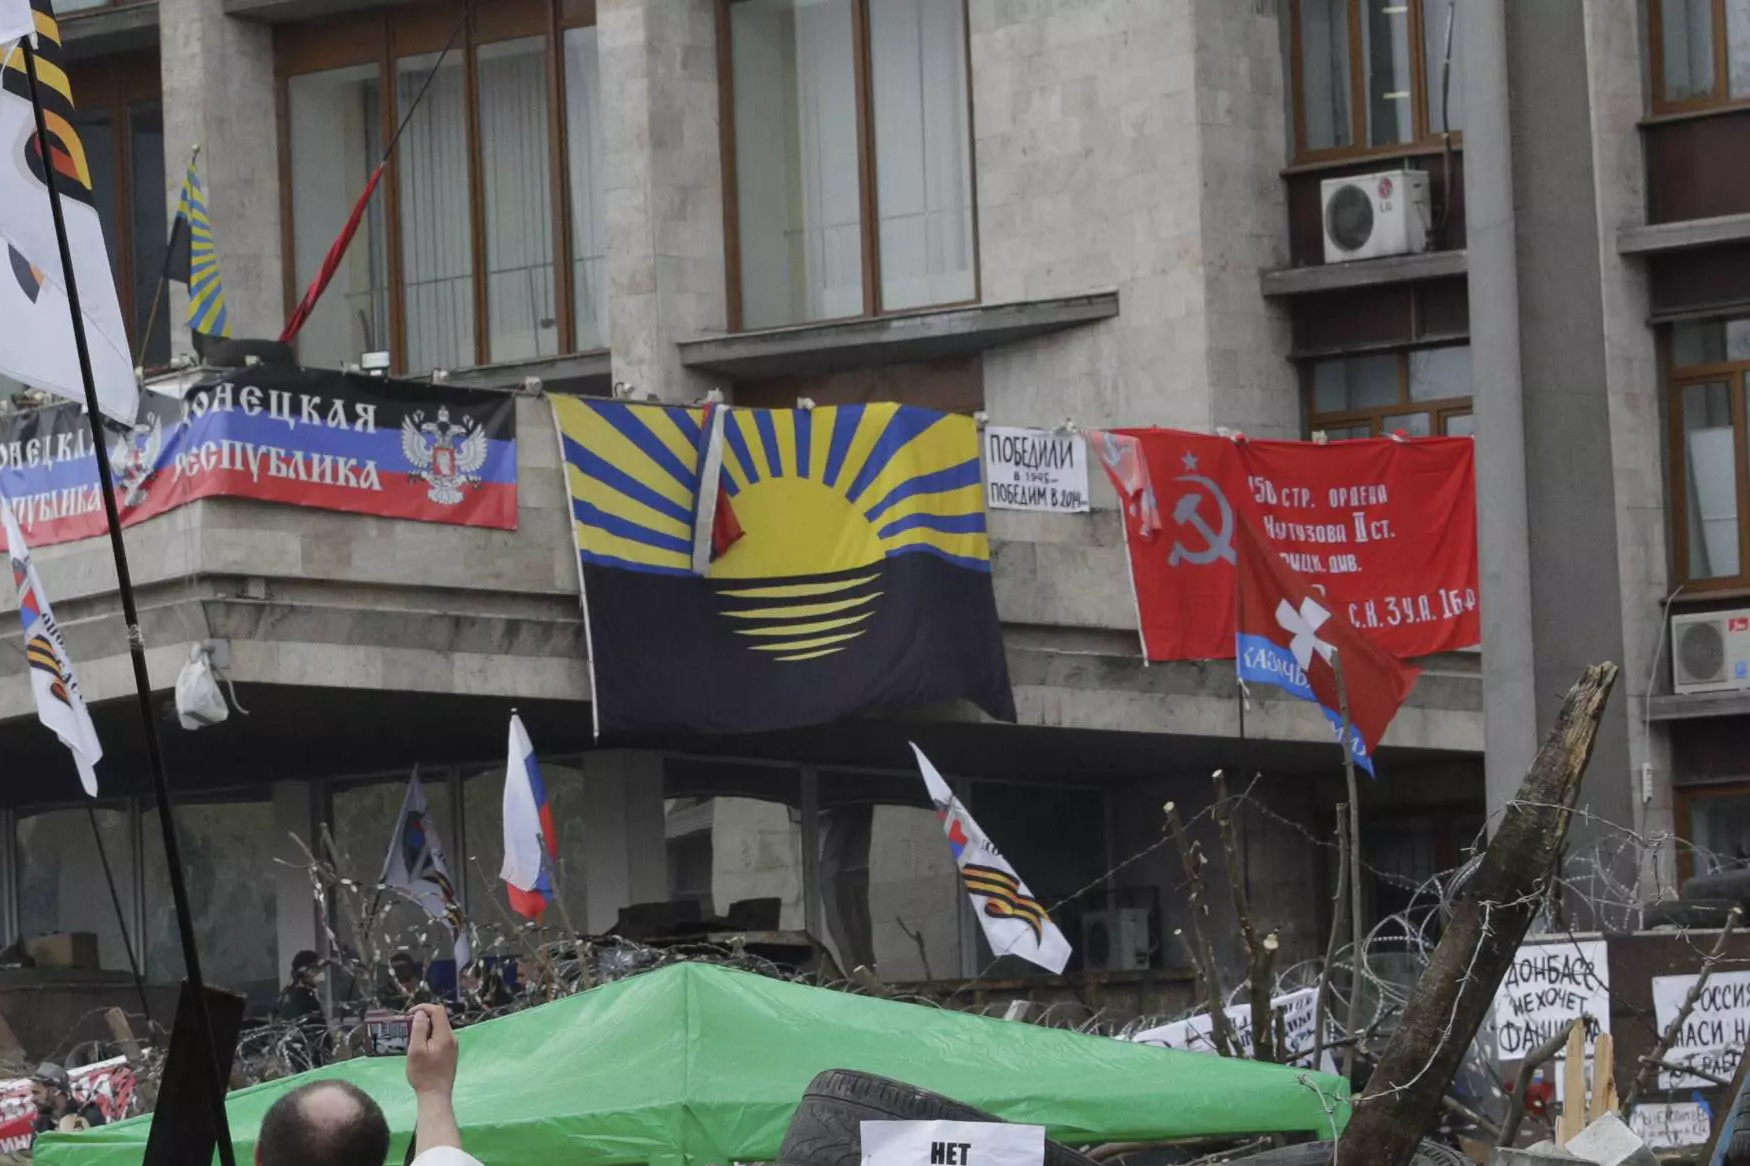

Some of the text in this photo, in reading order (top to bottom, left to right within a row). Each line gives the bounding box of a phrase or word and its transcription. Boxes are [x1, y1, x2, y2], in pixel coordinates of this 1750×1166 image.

[172, 439, 383, 491] РЕСПУБЛИКА
[990, 434, 1073, 470] ПОБЕДИЛИ
[991, 482, 1047, 506] ПОБЕДИМ
[1051, 487, 1058, 507] В
[1328, 484, 1388, 508] ОРДЕНА
[1263, 515, 1348, 543] КУТУЗОВА
[1505, 955, 1595, 990] ДОНБАСС
[931, 1141, 972, 1166] НЕТ
